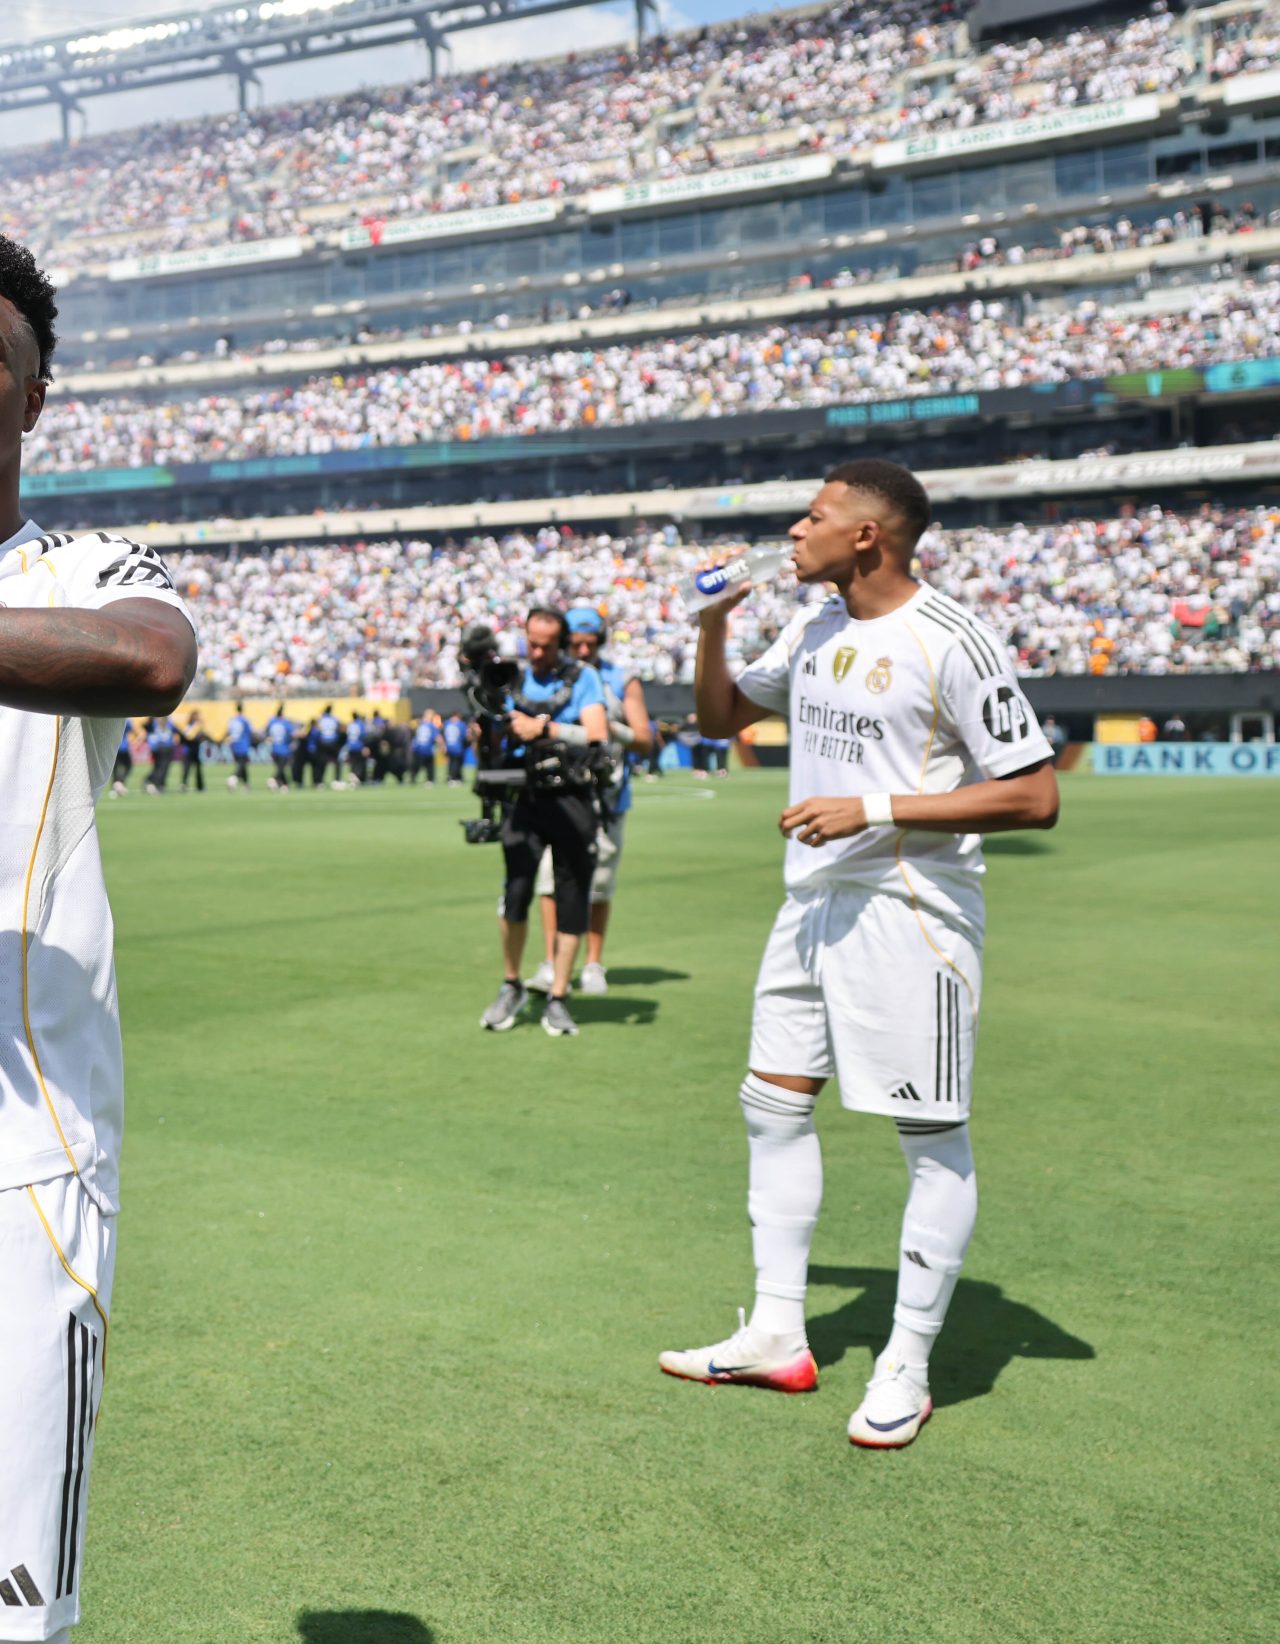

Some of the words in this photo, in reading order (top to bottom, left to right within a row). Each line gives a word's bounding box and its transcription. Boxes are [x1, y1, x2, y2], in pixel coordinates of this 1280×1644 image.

[701, 558, 750, 590] smart
[799, 696, 885, 741] Emirates
[820, 736, 864, 765] BETTER
[1105, 746, 1214, 769] BANK
[1231, 746, 1280, 771] OF
